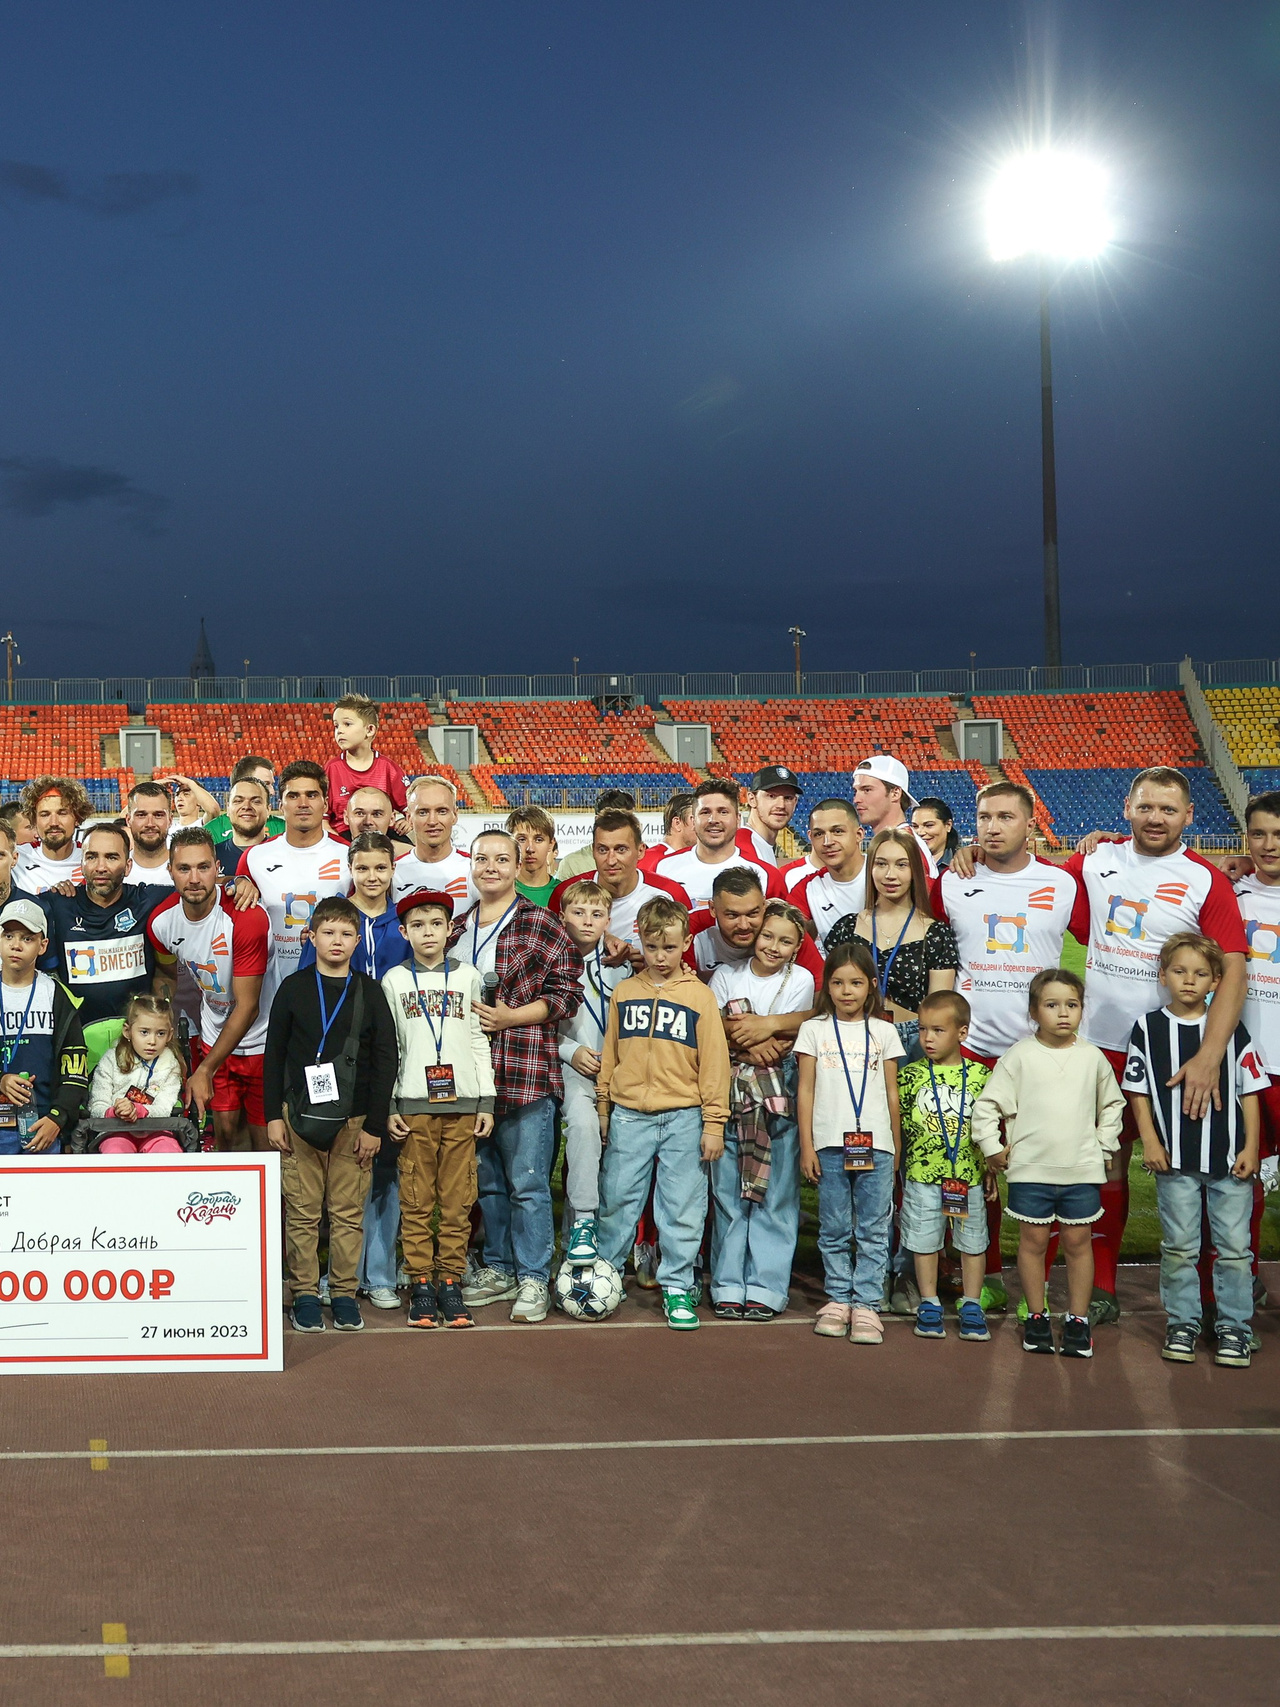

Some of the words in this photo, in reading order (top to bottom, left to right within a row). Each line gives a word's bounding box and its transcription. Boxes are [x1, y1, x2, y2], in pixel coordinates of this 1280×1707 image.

[100, 949, 144, 972] ВМЕСТЕ
[1116, 945, 1139, 957] боремся
[1002, 962, 1026, 973] боремся
[1125, 1055, 1145, 1083] 3
[186, 1190, 242, 1206] Добрая
[181, 1203, 237, 1226] Казань
[11, 1231, 81, 1255] Добрая
[91, 1226, 159, 1250] Казань
[141, 1326, 158, 1338] 27
[163, 1327, 205, 1338] июня
[210, 1325, 248, 1338] 2023
